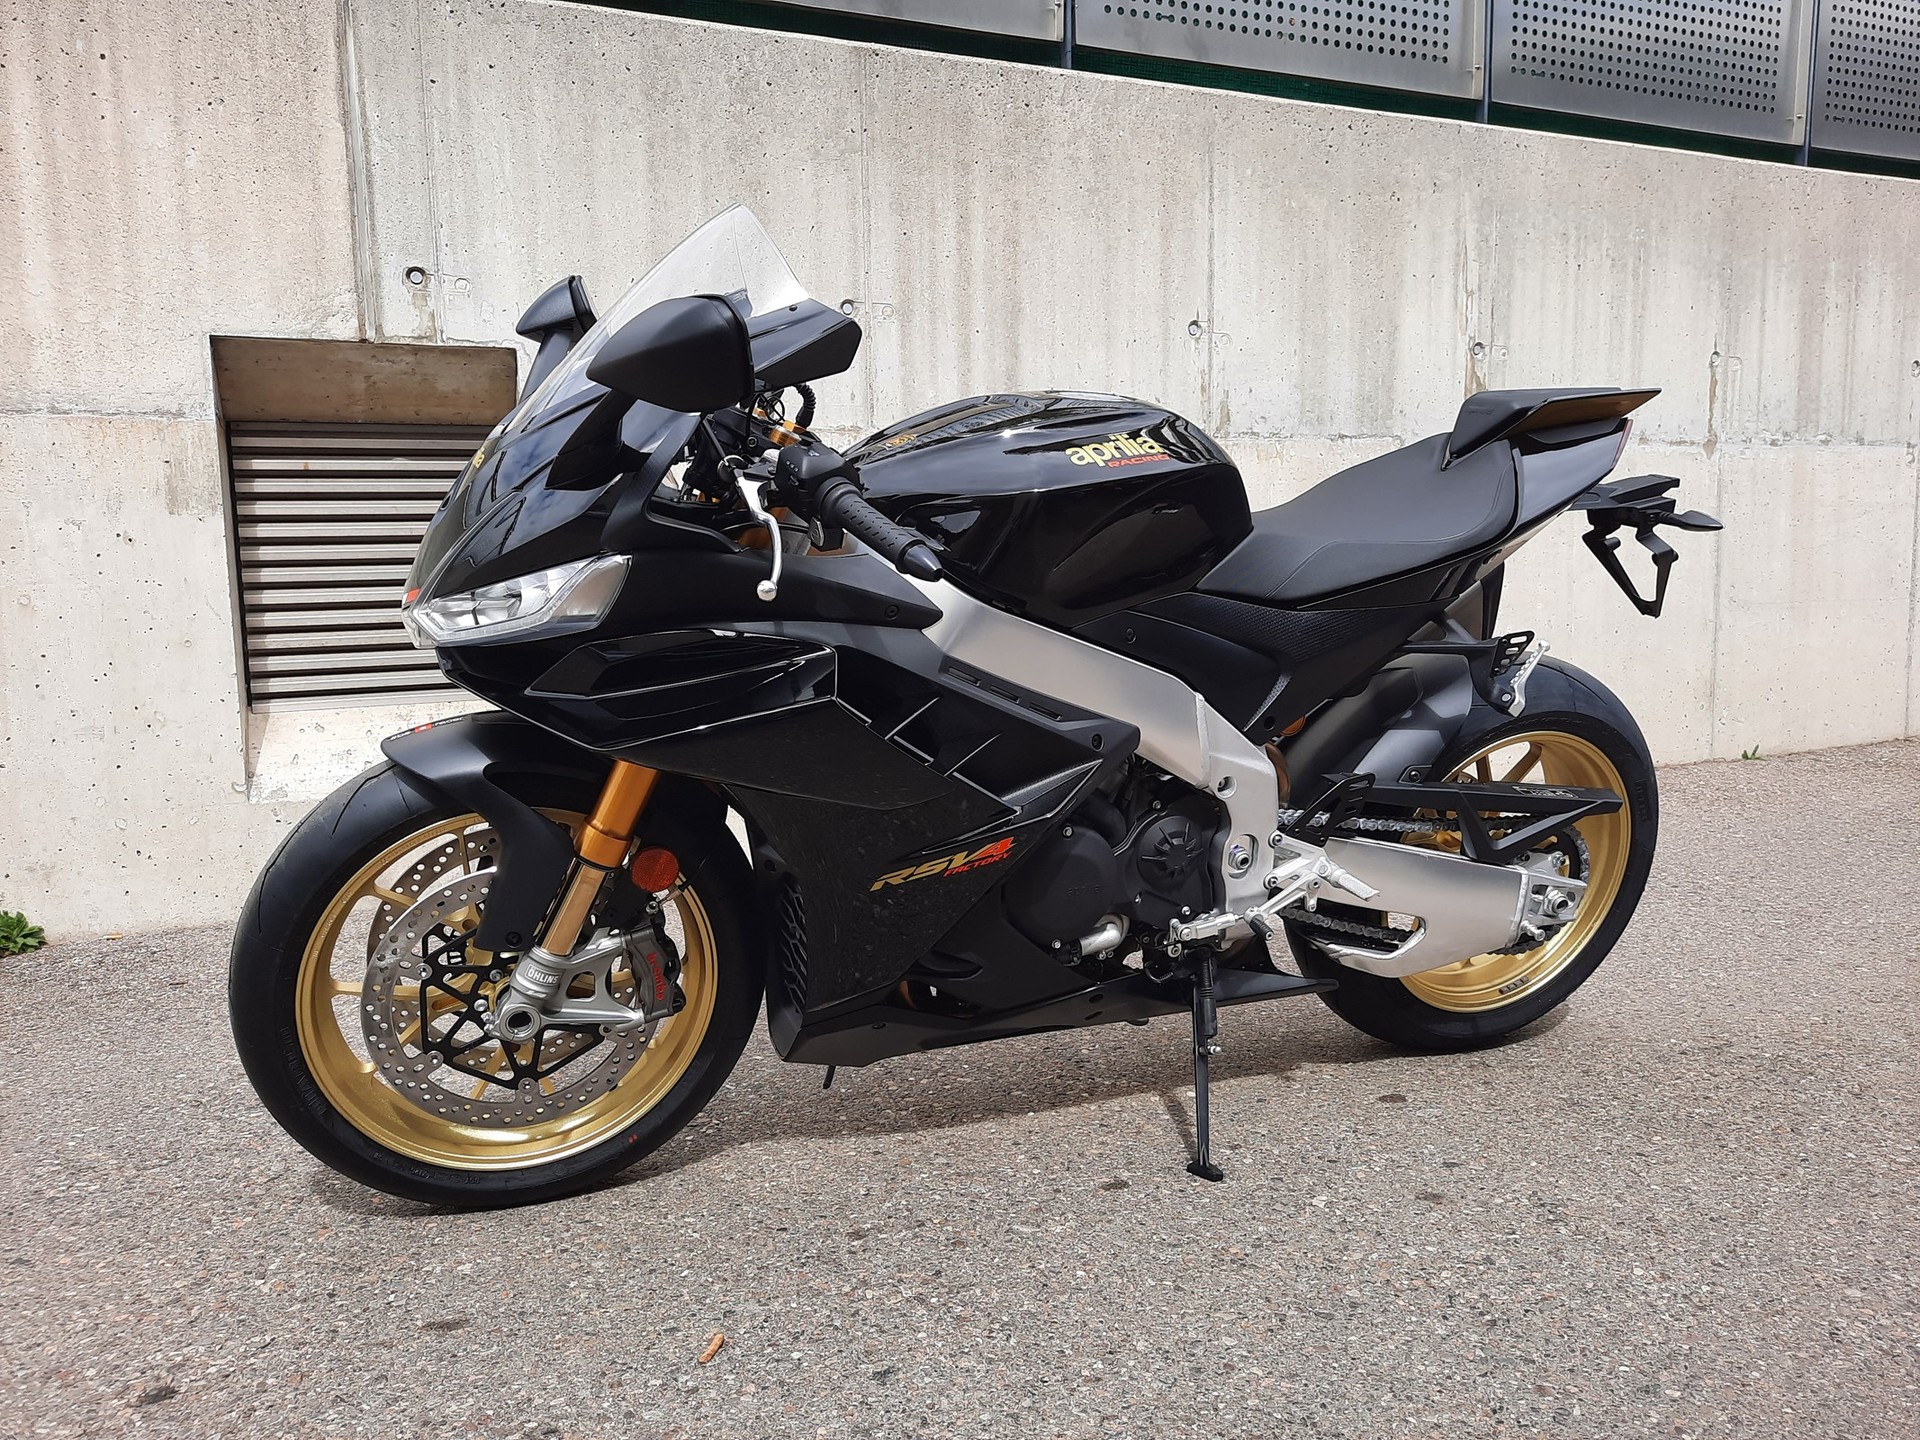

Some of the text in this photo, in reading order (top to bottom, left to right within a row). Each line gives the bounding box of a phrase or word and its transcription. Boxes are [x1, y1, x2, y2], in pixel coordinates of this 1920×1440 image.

[1065, 434, 1162, 467] aprilia
[1107, 453, 1171, 469] RACING
[869, 836, 1018, 893] RSV4
[943, 850, 1014, 878] FACTORY
[646, 952, 668, 1002] brembo
